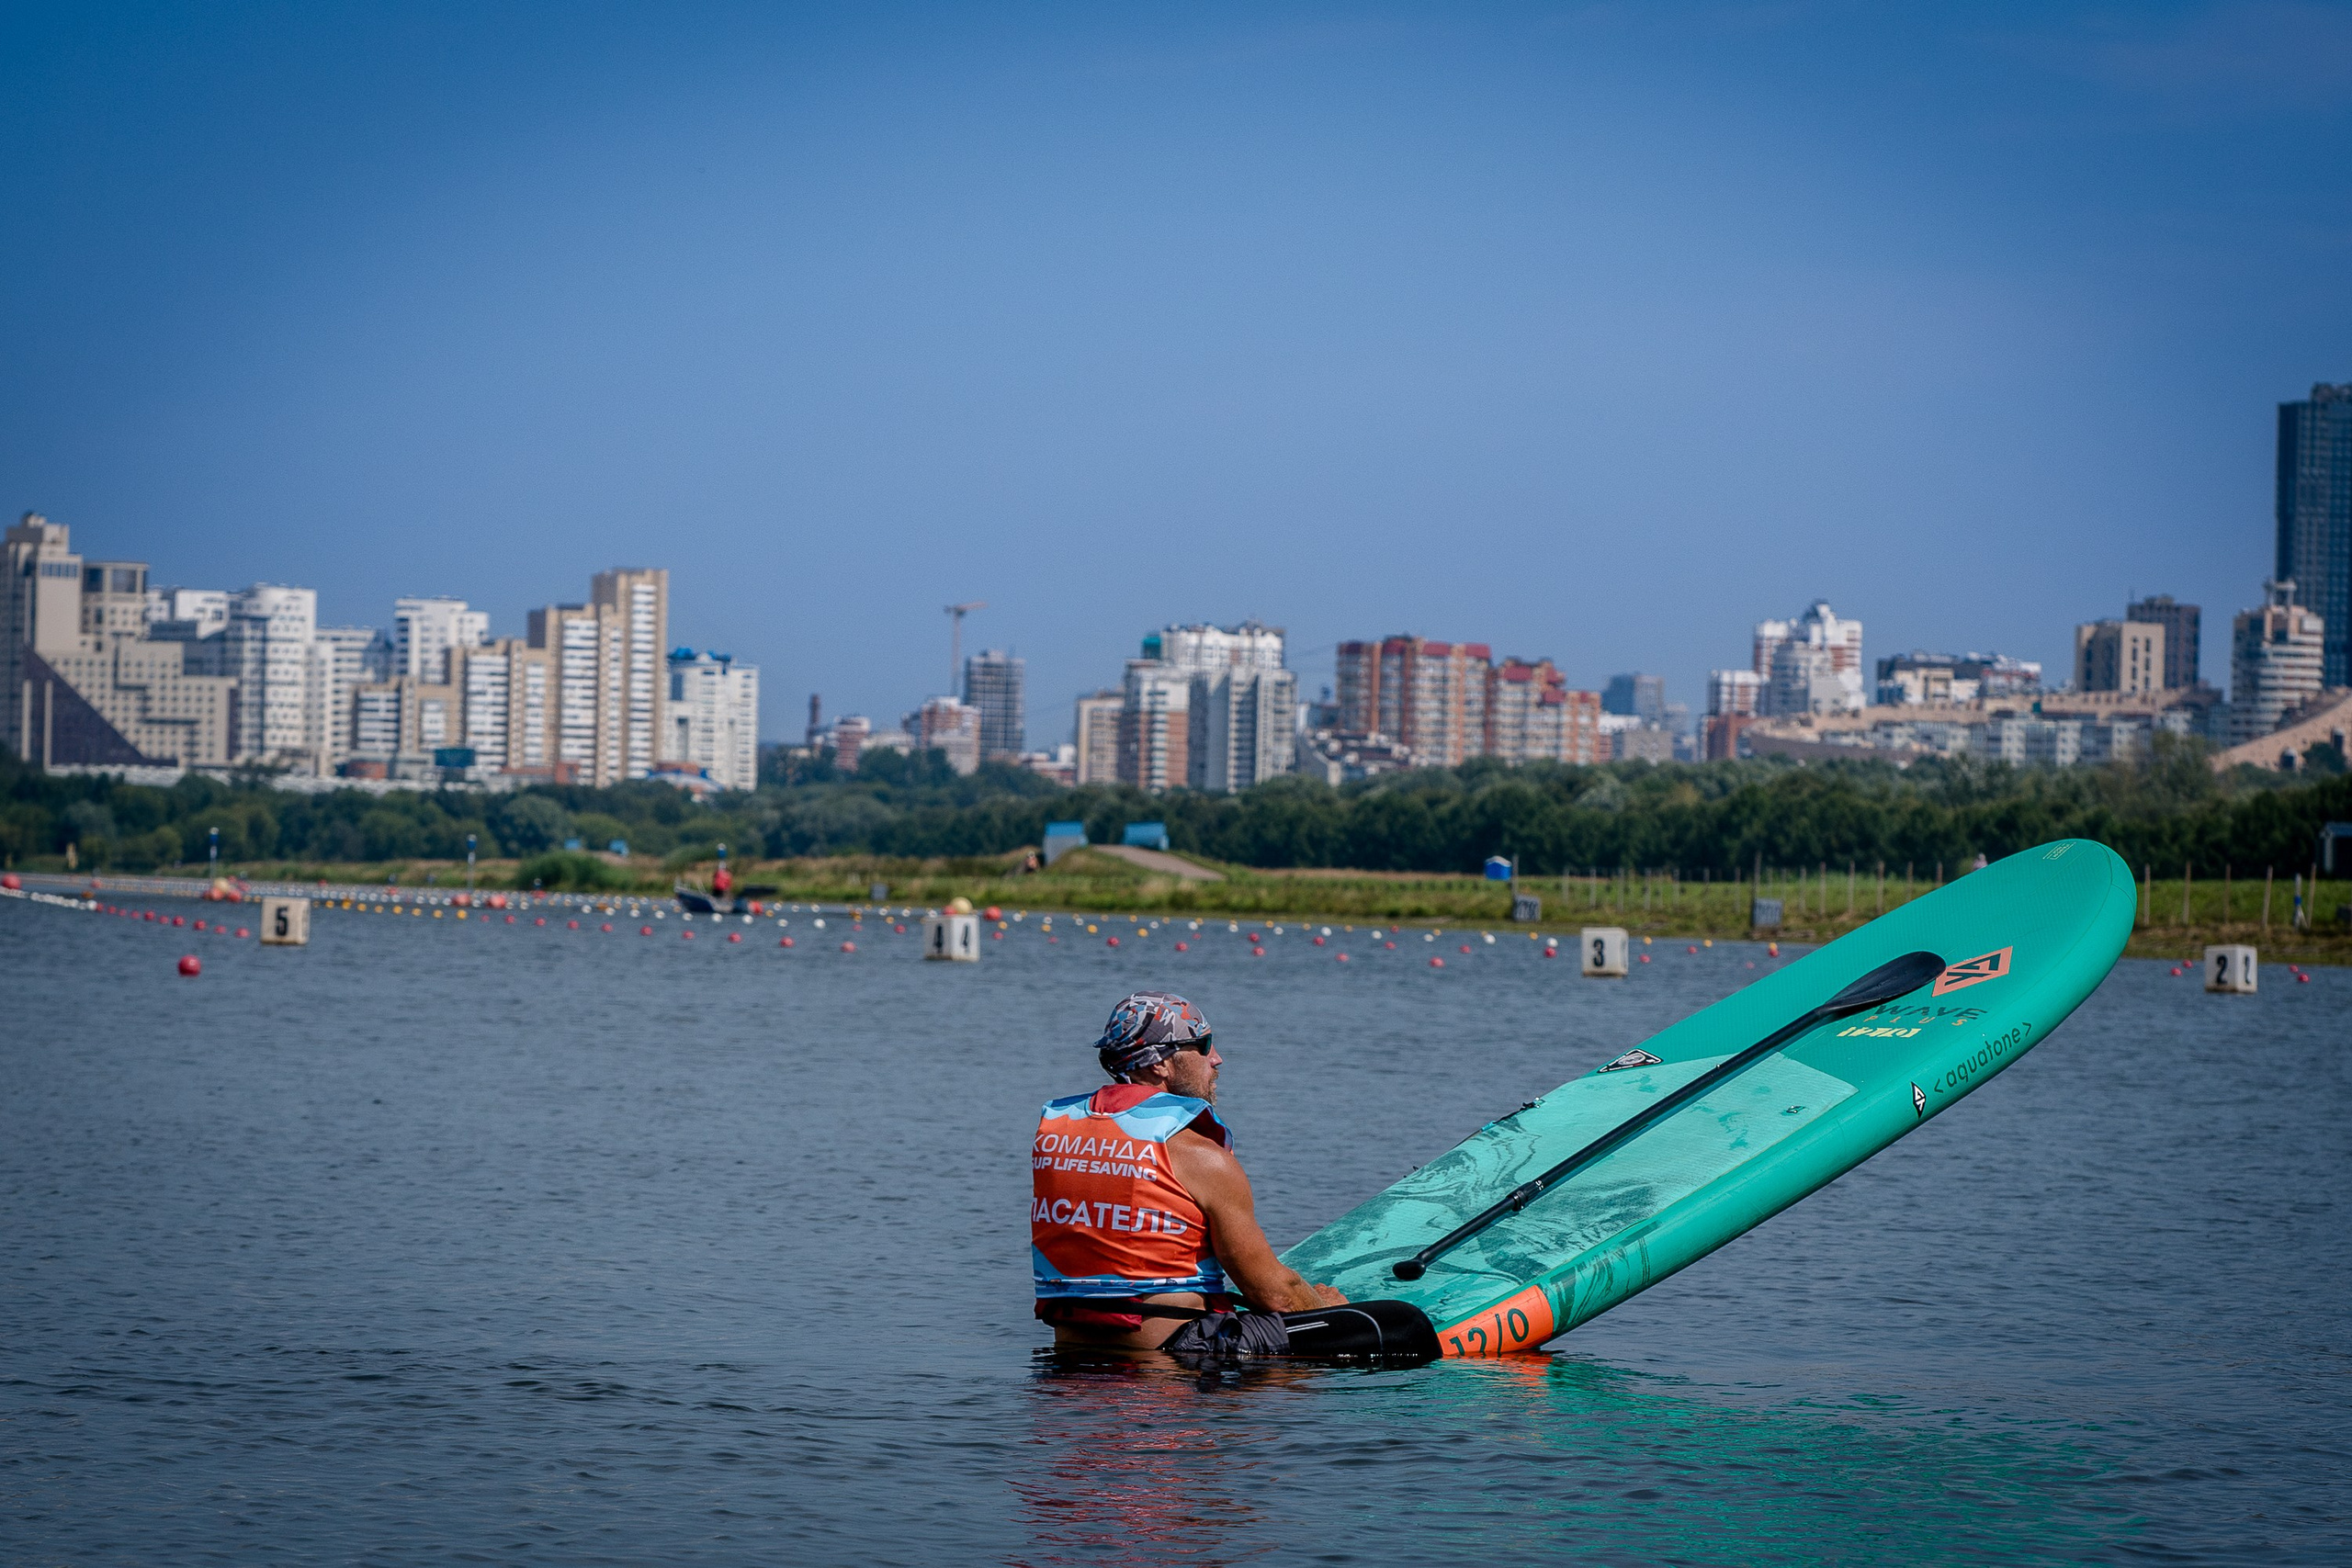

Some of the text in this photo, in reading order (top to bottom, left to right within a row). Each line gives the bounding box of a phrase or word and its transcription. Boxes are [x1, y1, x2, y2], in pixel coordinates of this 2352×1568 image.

[276, 906, 288, 936] 5
[1592, 938, 1605, 967] 3
[2216, 954, 2228, 985] 2
[1874, 1005, 1987, 1021] WAVE
[1054, 1157, 1088, 1173] LIFE
[1089, 1160, 1158, 1182] SAVING
